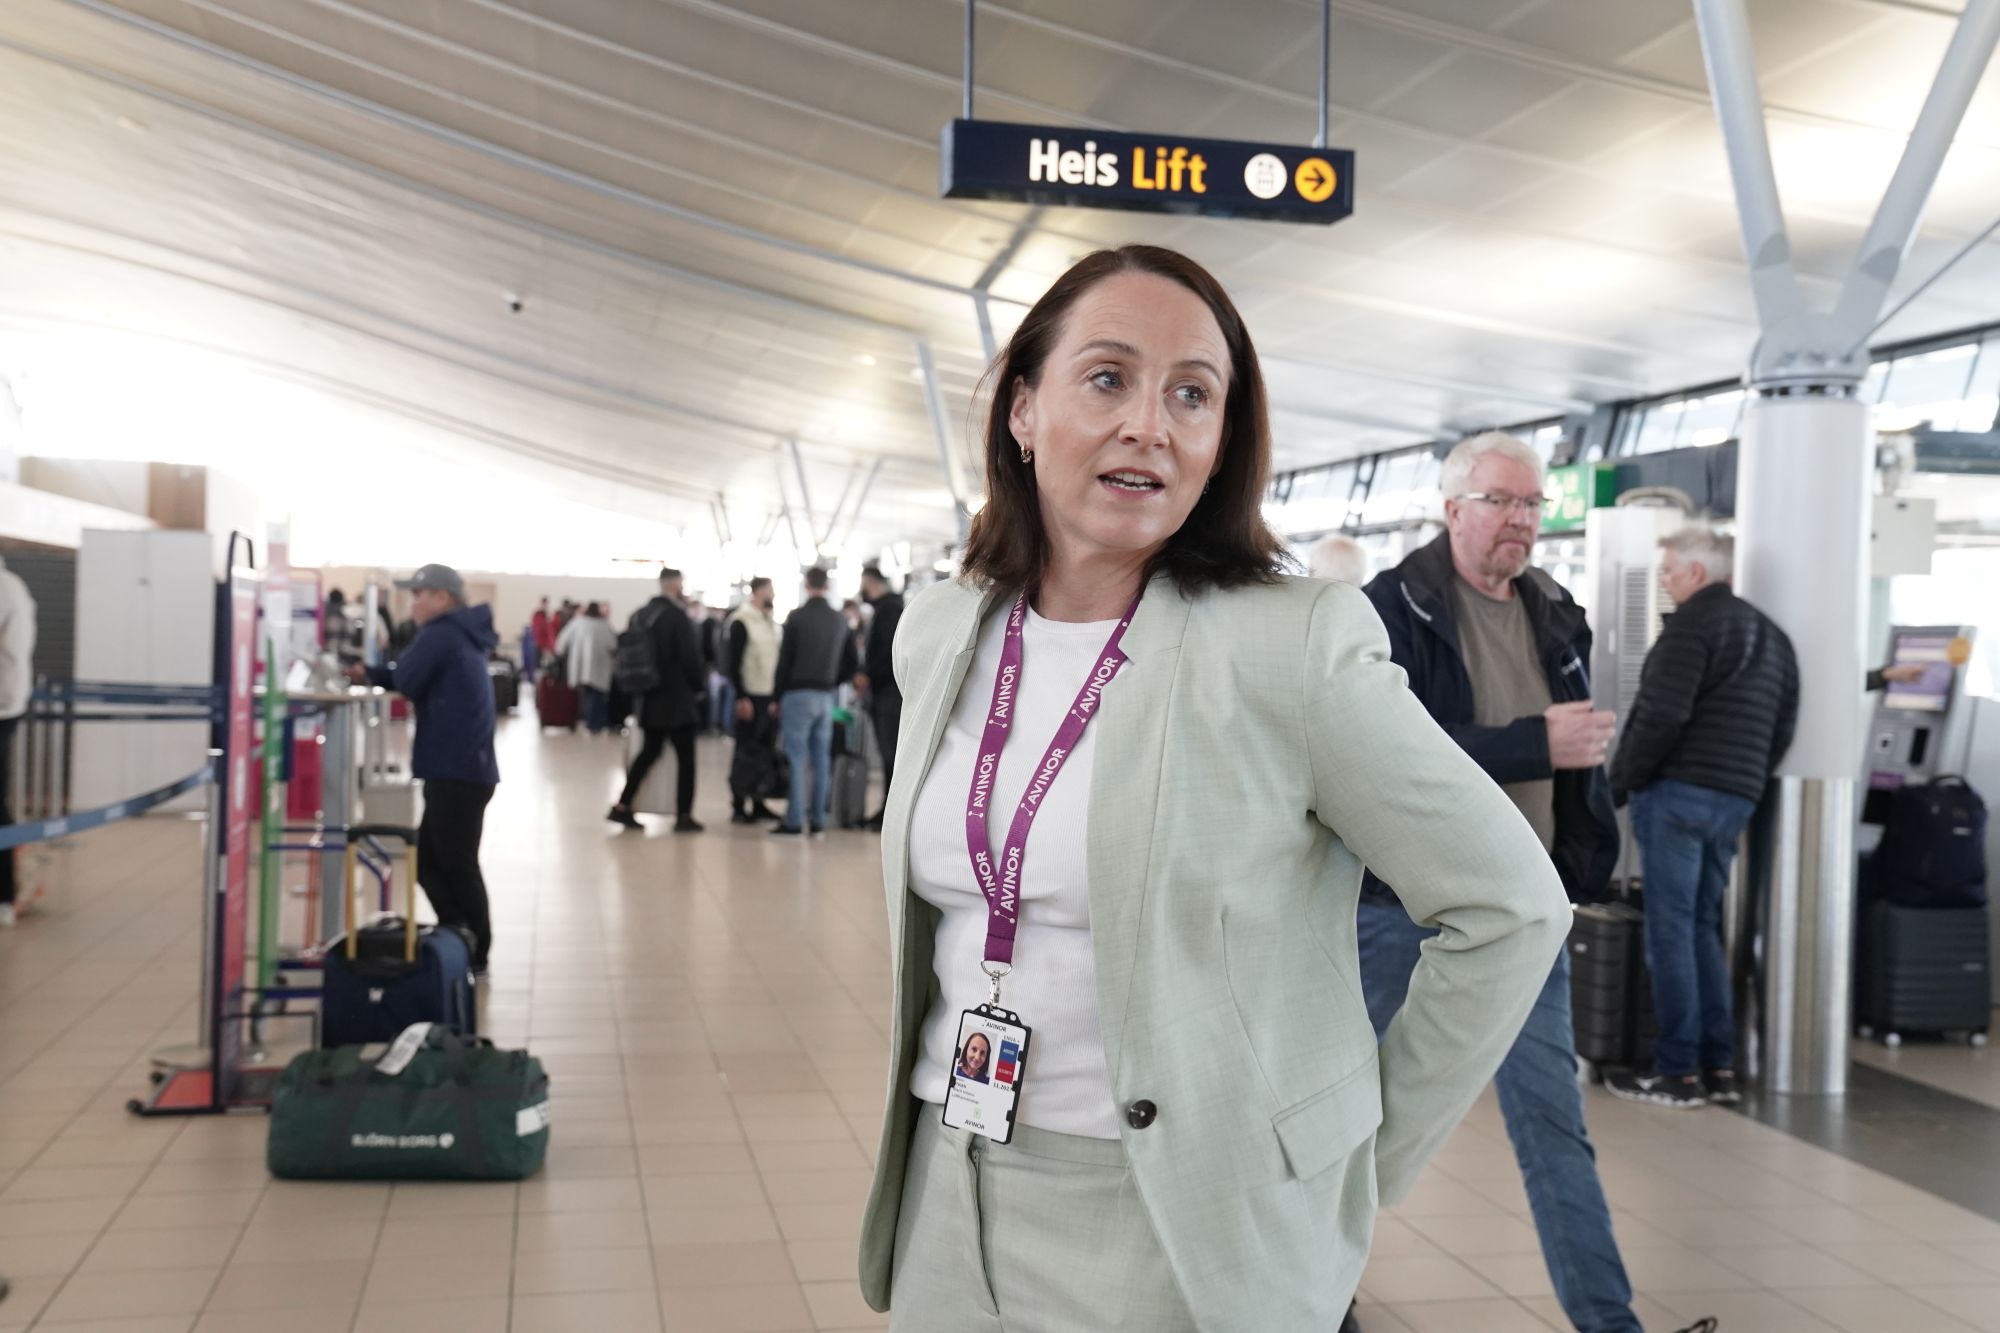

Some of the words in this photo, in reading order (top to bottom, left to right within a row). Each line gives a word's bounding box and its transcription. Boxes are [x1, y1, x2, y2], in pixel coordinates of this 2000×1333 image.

[1029, 138, 1119, 187] Heis
[1132, 146, 1208, 193] Lift
[994, 664, 1017, 718] AVINOR
[1080, 656, 1118, 713] AVINOR
[973, 752, 996, 808] AVINOR
[1027, 748, 1067, 805] AVINOR
[1000, 846, 1021, 912] AVINOR
[985, 1021, 1007, 1033] AVINOR
[964, 1119, 985, 1131] AVINOR
